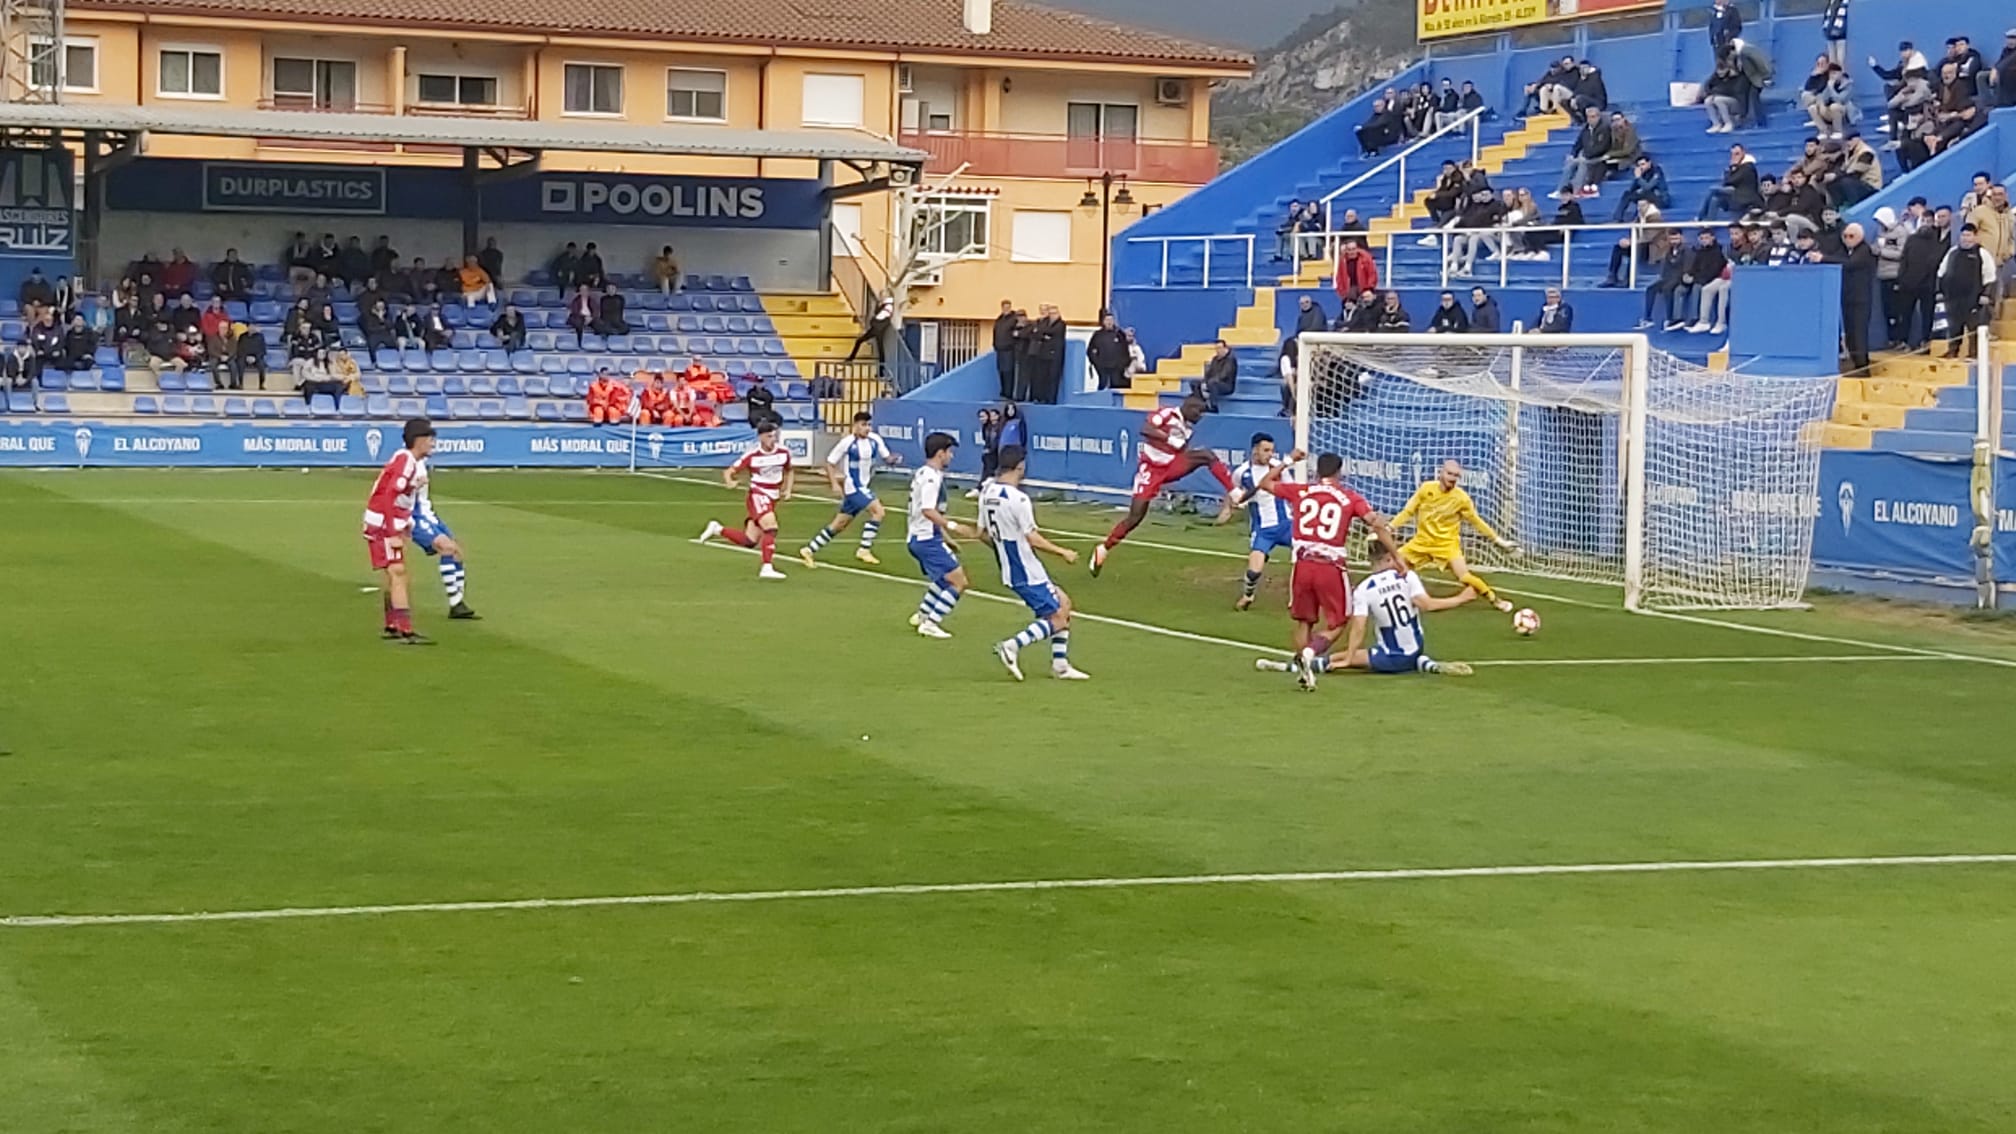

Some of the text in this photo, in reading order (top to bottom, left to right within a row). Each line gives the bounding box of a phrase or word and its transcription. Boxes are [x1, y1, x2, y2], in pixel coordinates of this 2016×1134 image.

[220, 176, 373, 200] DURPLASTICS
[583, 181, 765, 219] POOLINS
[28, 436, 56, 452] QUE
[114, 437, 201, 451] EL ALCOYANO
[243, 435, 348, 452] MÁS MORAL QUE
[531, 436, 630, 454] MÁS MORAL QUE
[683, 442, 698, 454] EL
[1299, 498, 1342, 540] 29
[1874, 500, 1958, 527] EL ALCOYANO
[988, 509, 1001, 543] 5
[1380, 593, 1412, 628] 16
